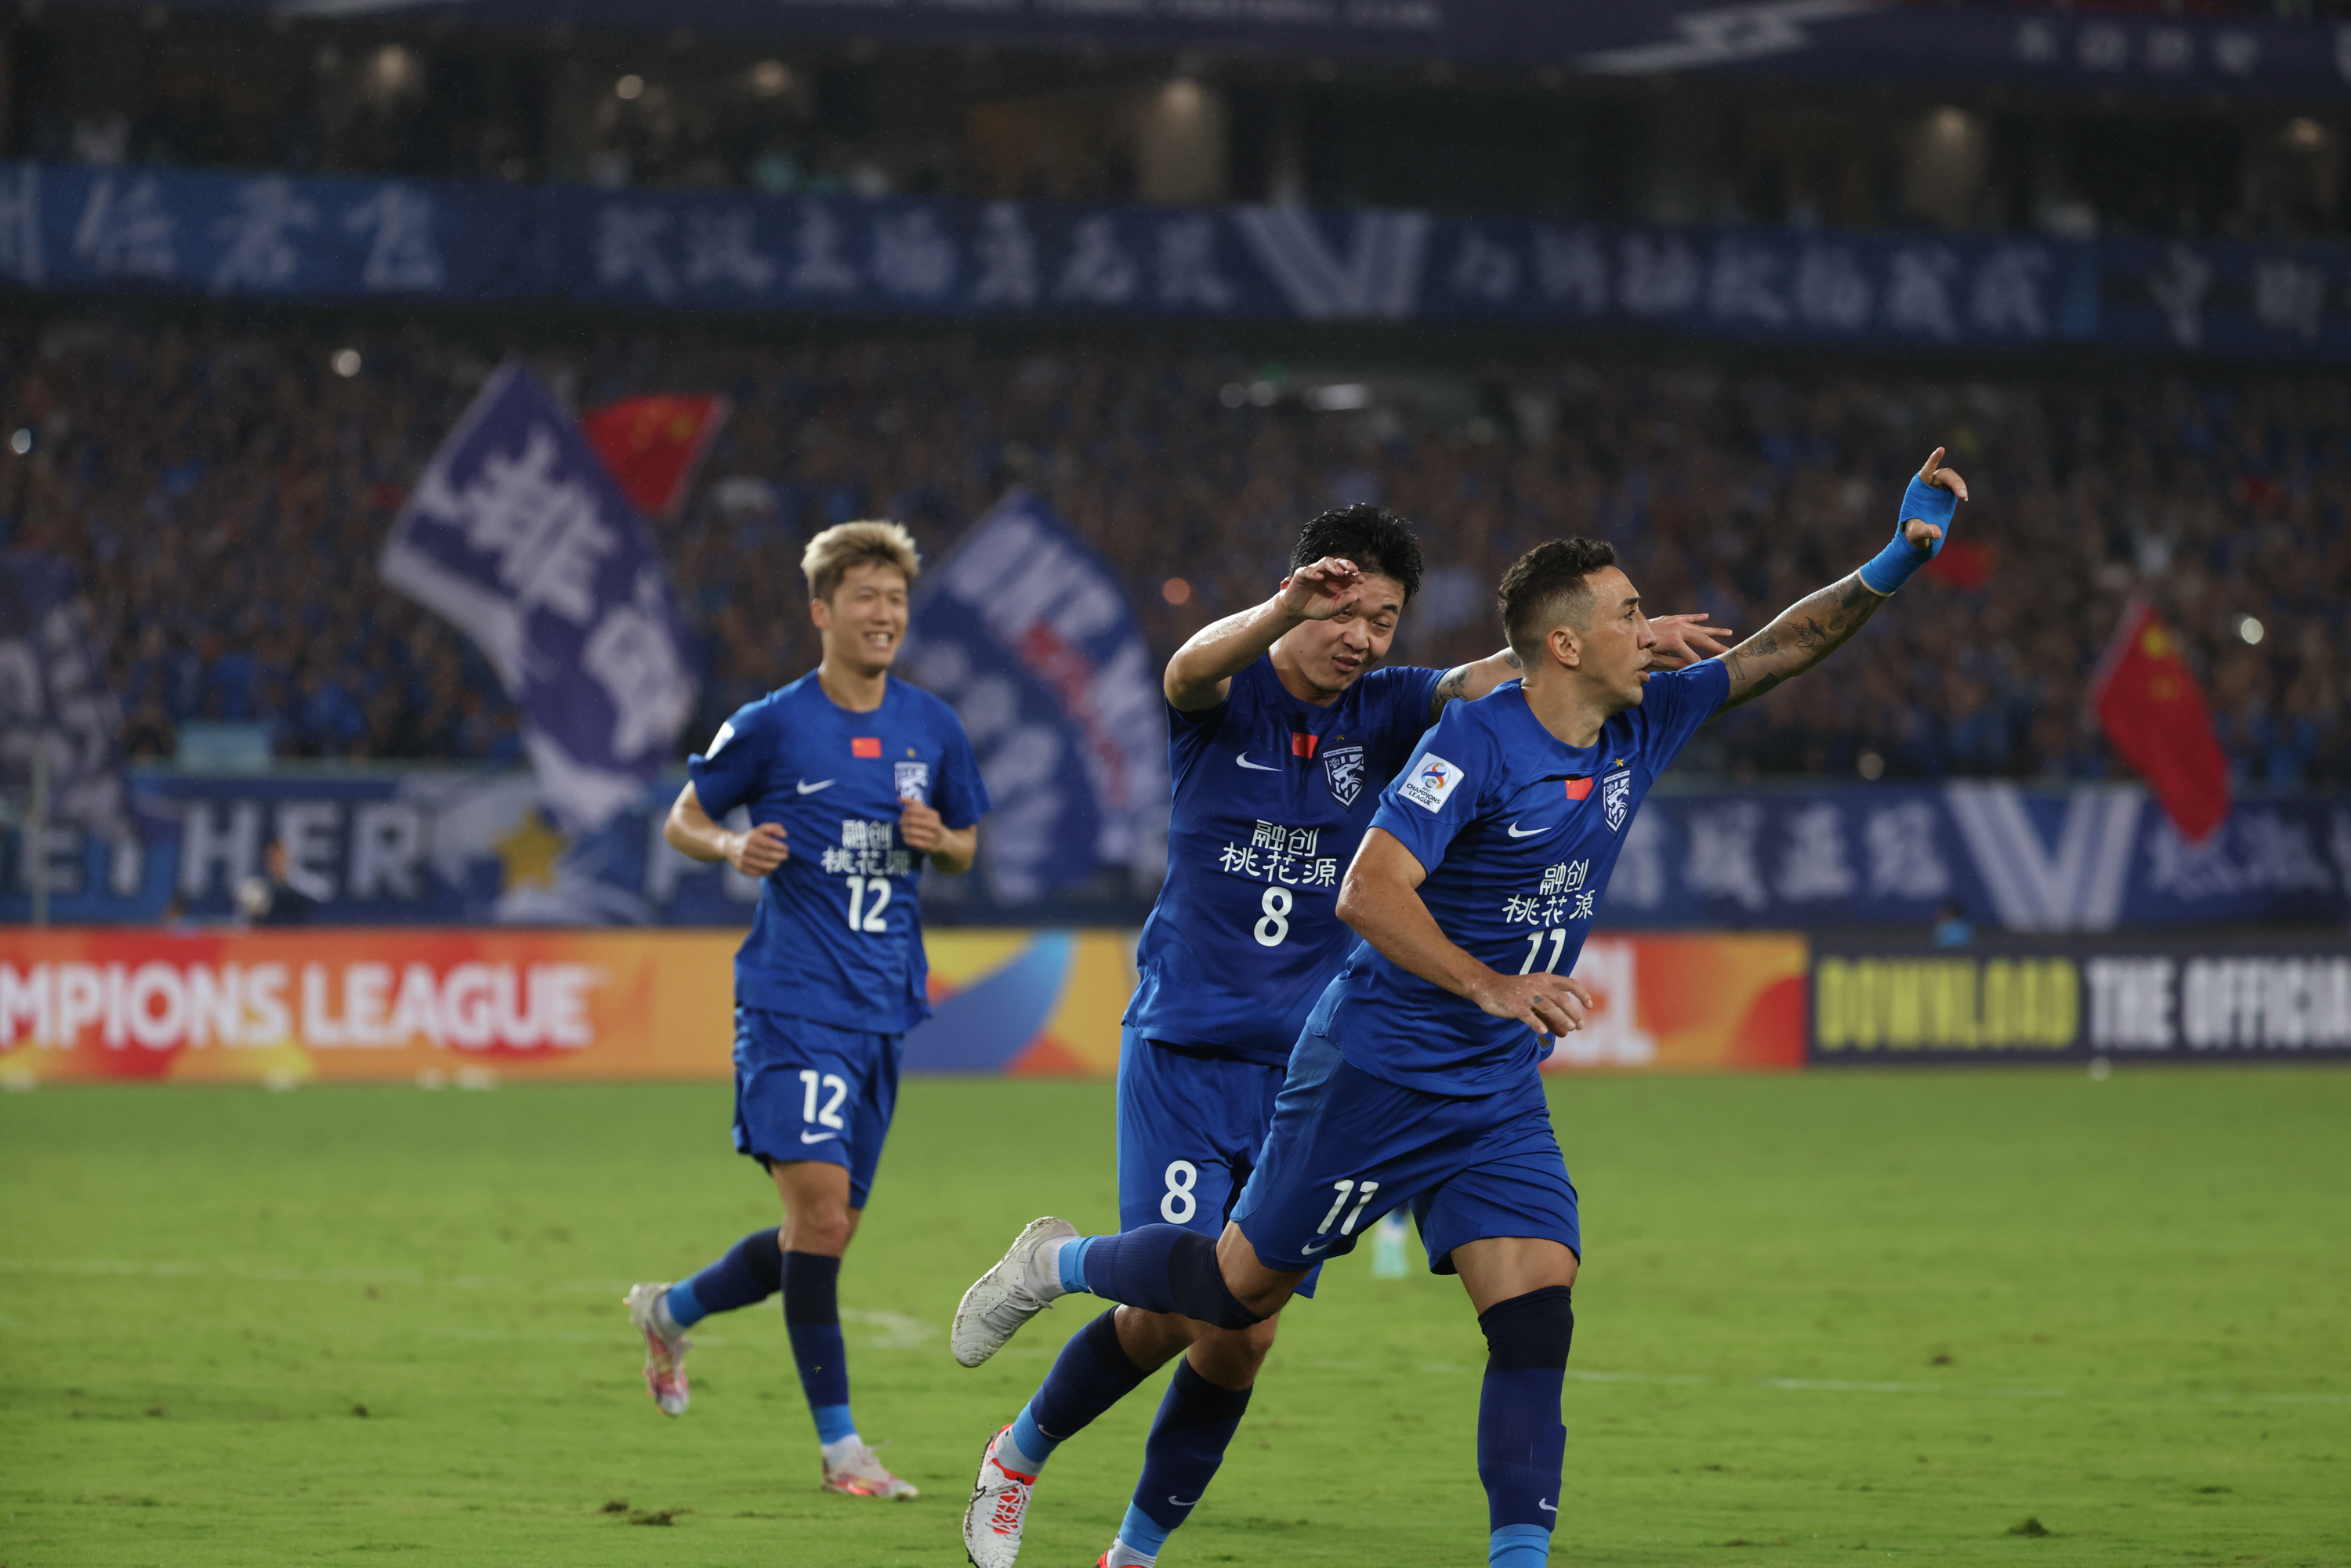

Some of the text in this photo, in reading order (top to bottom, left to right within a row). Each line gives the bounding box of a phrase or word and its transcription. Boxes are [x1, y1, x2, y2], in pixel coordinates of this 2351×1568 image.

[1407, 783, 1441, 805] CHAMPIONS
[1409, 791, 1432, 806] LEAGUE
[1252, 819, 1320, 857] 融创
[1219, 842, 1337, 888] 桃花源
[1539, 858, 1589, 896] 融创
[846, 875, 892, 932] 12
[1254, 886, 1293, 947] 8
[1502, 889, 1596, 928] 桃花源
[1519, 928, 1567, 976] 11
[301, 961, 593, 1048] LEAGUE
[1817, 956, 2078, 1050] DOWNLOAD
[2085, 956, 2176, 1050] THE
[799, 1070, 848, 1130] 12
[1160, 1160, 1197, 1224] 8
[1317, 1179, 1379, 1235] 11
